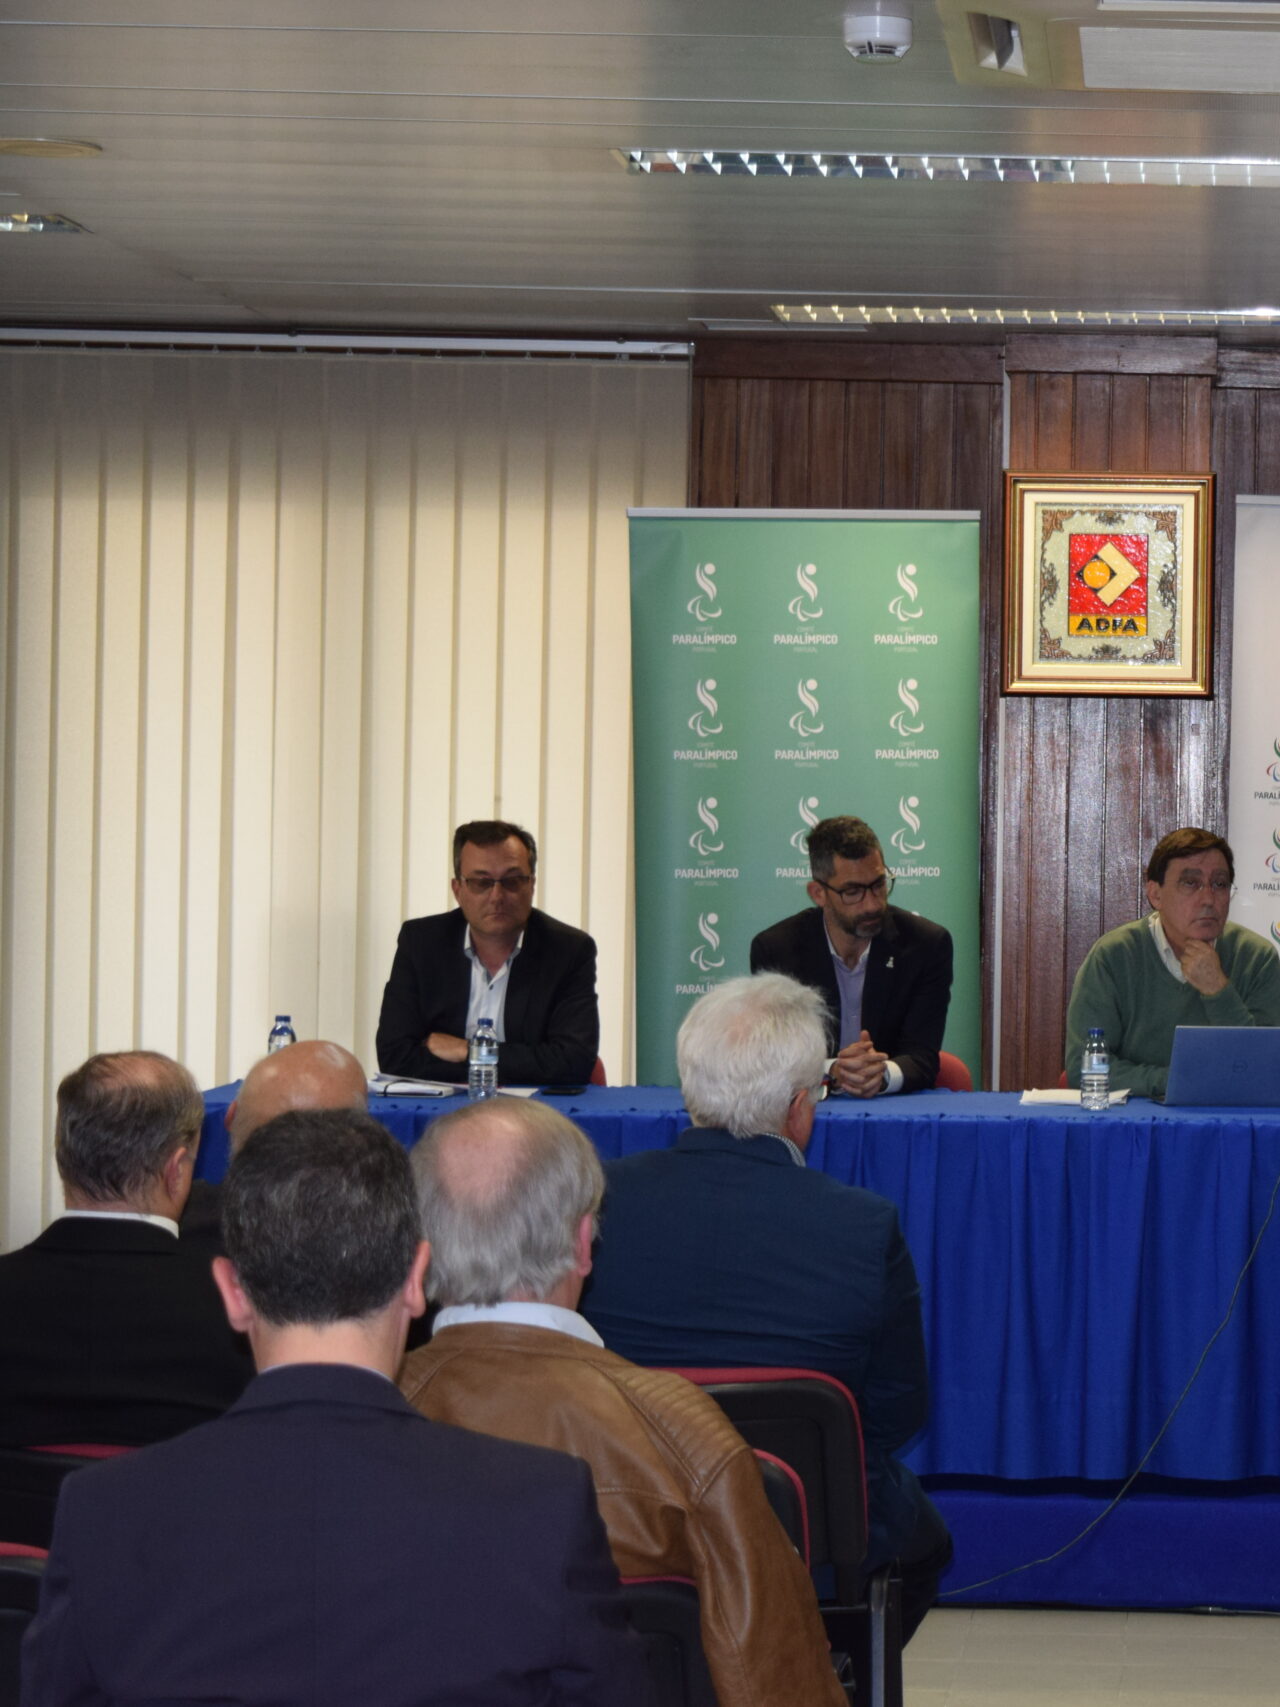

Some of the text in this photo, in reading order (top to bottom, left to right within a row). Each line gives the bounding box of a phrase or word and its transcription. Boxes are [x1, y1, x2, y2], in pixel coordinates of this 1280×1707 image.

[1076, 617, 1140, 632] ADFA
[672, 632, 737, 645] PARALÍMPICO
[773, 632, 838, 645] PARALÍMPICO
[874, 632, 938, 645] PARALÍMPICO
[673, 748, 738, 760] PARALÍMPICO
[774, 748, 839, 760] PARALÍMPICO
[875, 748, 939, 760] PARALÍMPICO
[674, 866, 739, 879] PARALÍMPICO
